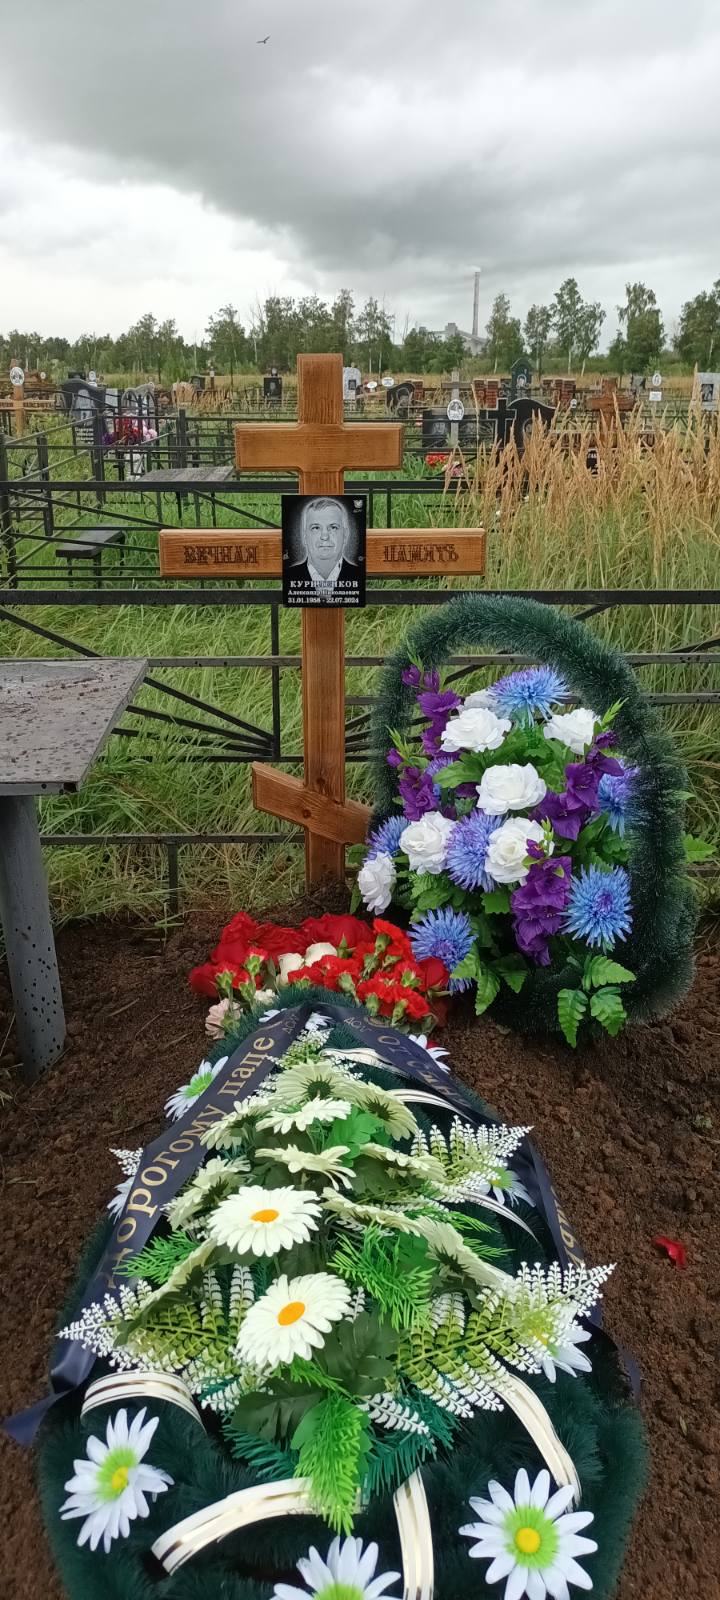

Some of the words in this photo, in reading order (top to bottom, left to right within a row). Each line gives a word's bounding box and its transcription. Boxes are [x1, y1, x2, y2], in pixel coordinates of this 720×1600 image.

[183, 545, 259, 564] ВЕЧНАЯ
[383, 543, 459, 563] ПАМЯТЬ
[217, 1035, 275, 1097] папе
